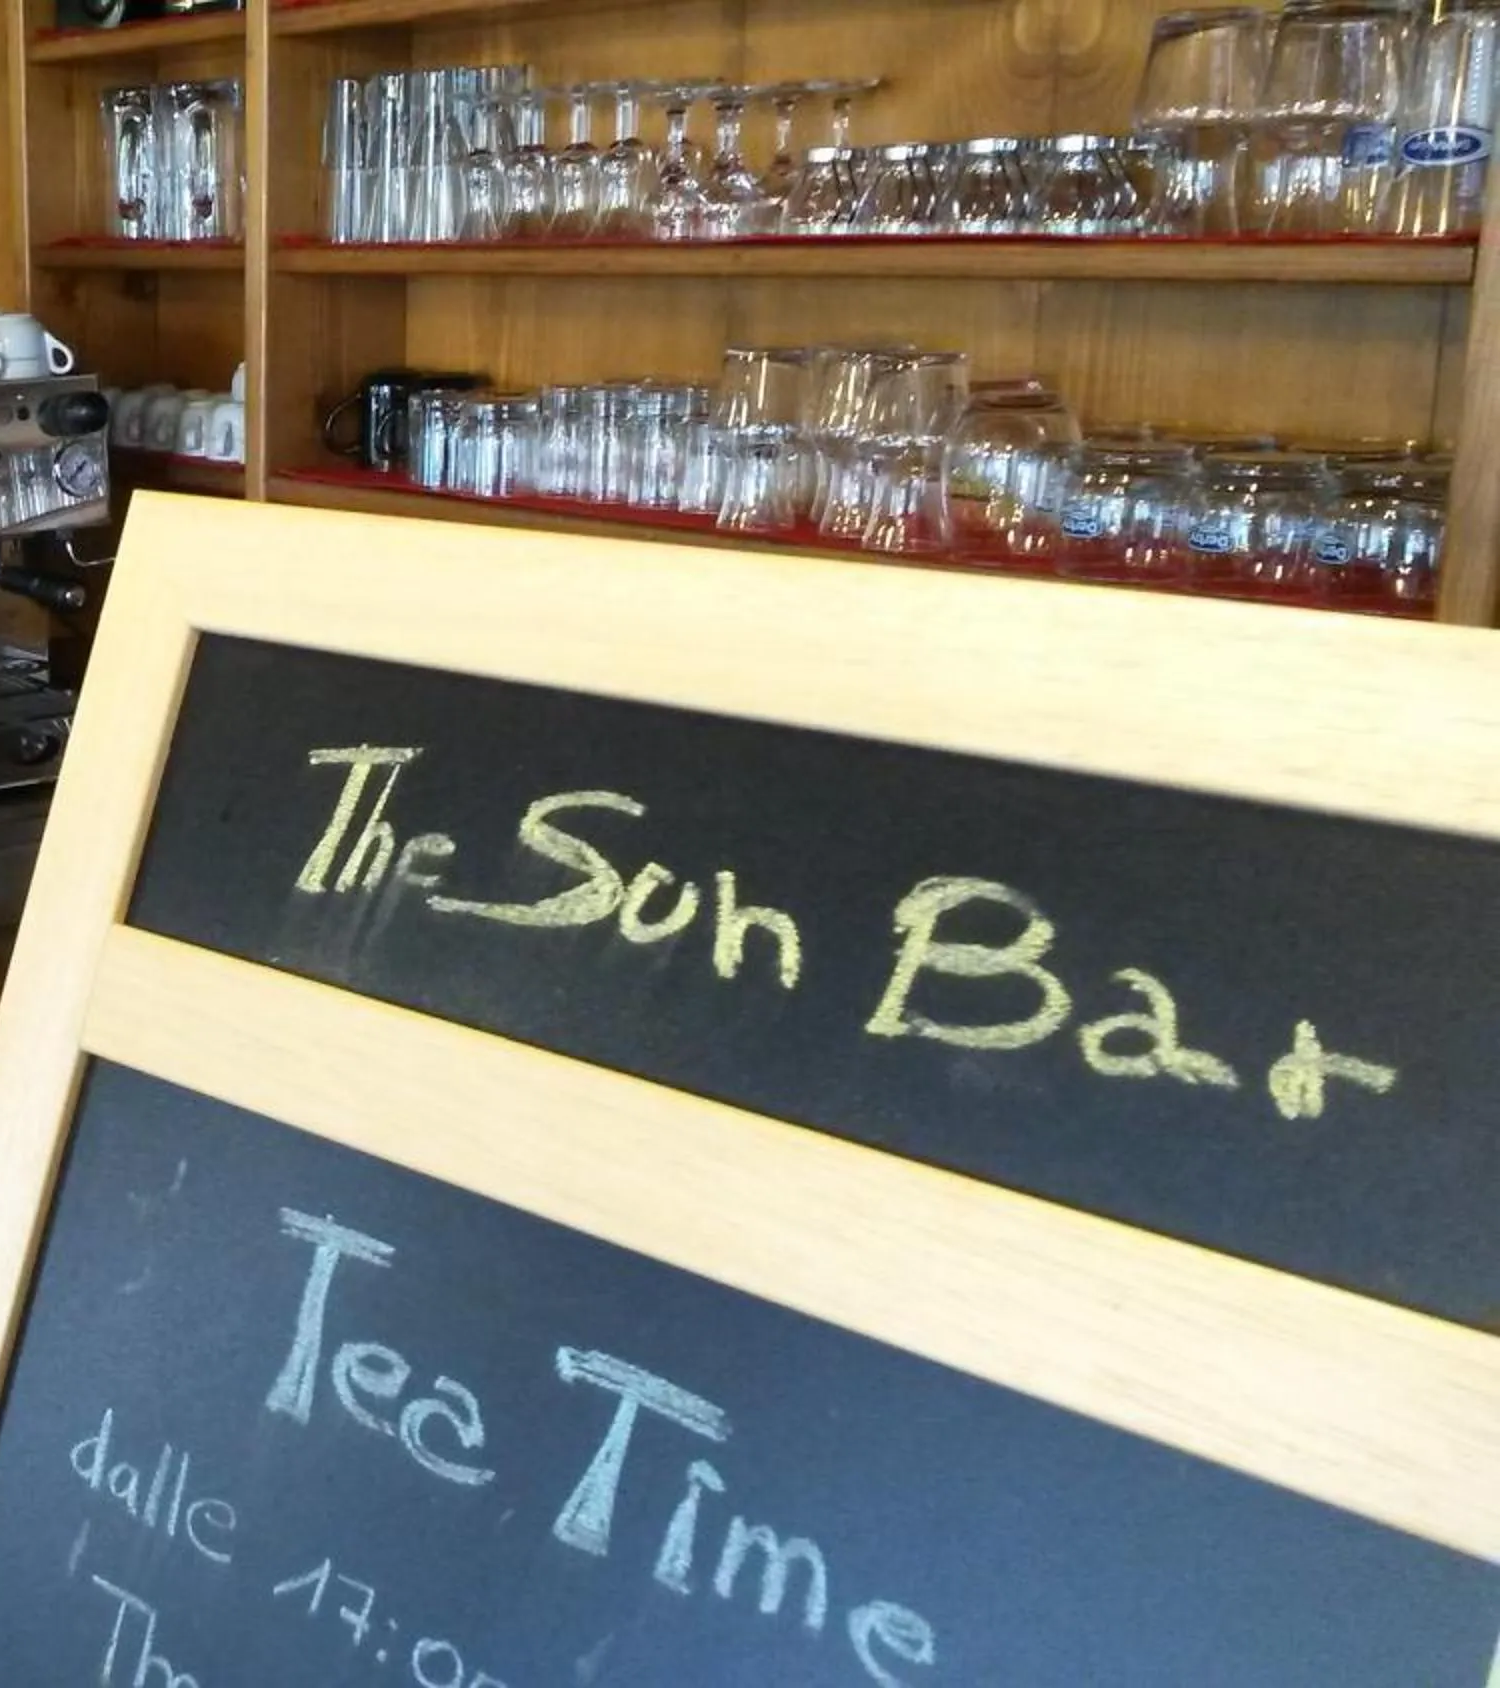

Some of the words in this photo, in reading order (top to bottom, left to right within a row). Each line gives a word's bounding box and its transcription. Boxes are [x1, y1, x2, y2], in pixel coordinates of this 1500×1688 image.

[295, 743, 456, 893] The
[426, 790, 801, 989] Sun
[865, 876, 1396, 1119] Bar
[70, 1408, 236, 1563] dalle
[265, 1206, 496, 1485] Tea
[553, 1346, 935, 1688] Time
[92, 1574, 199, 1688] Th
